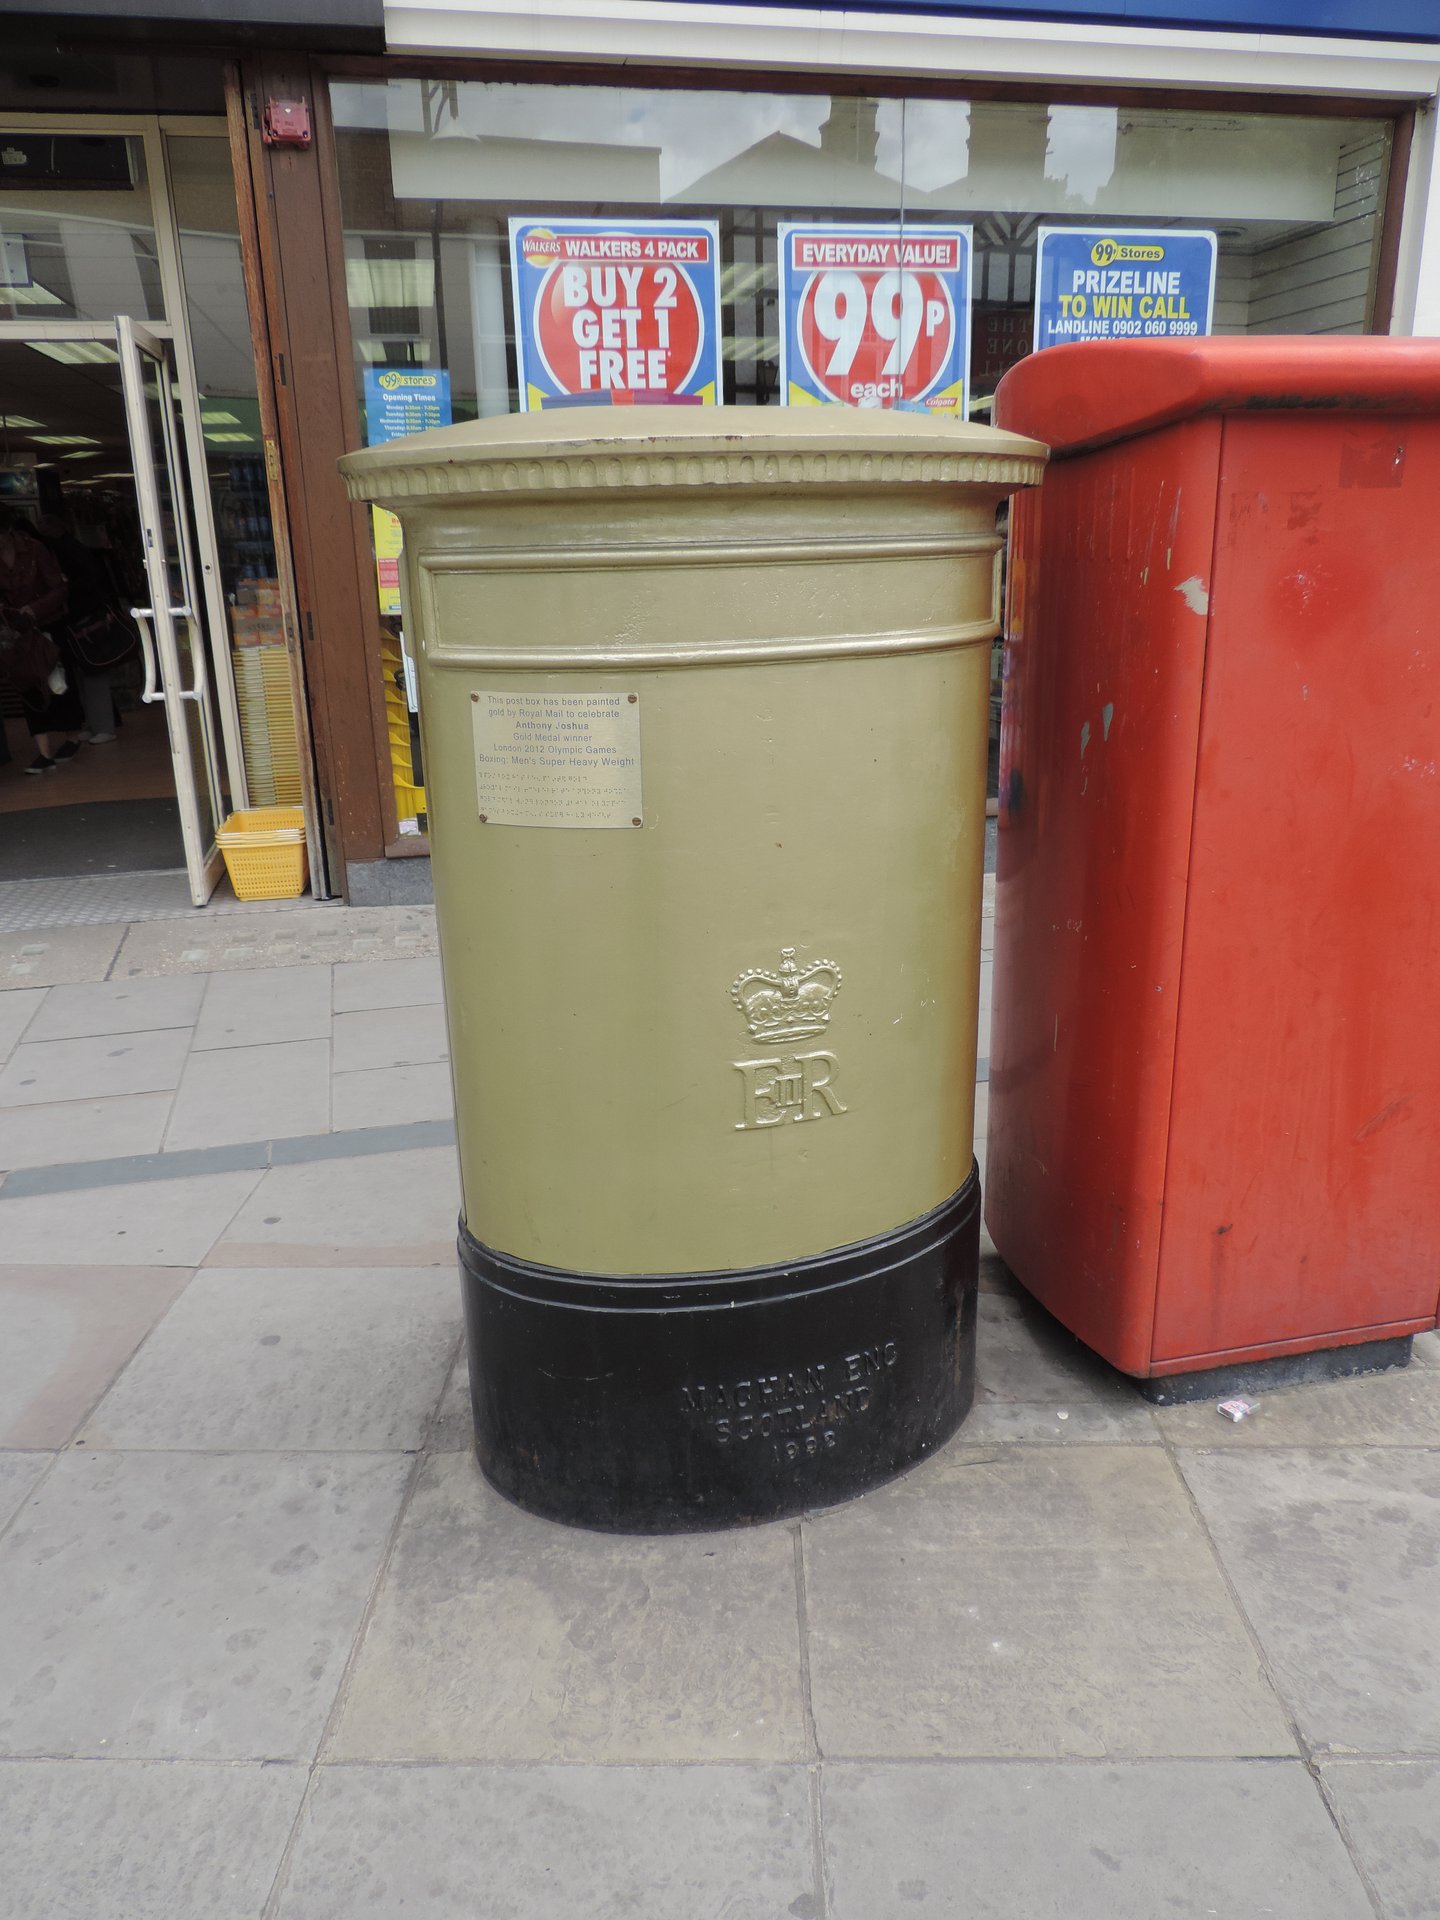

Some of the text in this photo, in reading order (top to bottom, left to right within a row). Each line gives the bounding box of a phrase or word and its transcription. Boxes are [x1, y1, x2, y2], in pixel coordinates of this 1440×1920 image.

[523, 239, 561, 253] WALKERS
[565, 240, 699, 258] WALKERS 4 PACK
[1121, 247, 1160, 259] Stores
[803, 243, 951, 264] EVERYDAY VALUE!
[563, 266, 678, 308] BUY 2
[1072, 270, 1181, 294] PRIZELINE
[1059, 294, 1190, 319] TO WIN CALL
[572, 309, 670, 349] GET 1
[1048, 320, 1198, 335] LANDLINE 0902 060 9999
[404, 376, 433, 385] stores
[850, 379, 903, 398] each
[383, 393, 436, 403] Opening Times
[926, 398, 955, 407] Colgate
[488, 696, 503, 704] This
[506, 697, 523, 706] post
[543, 698, 559, 706] has
[561, 698, 584, 706] been
[586, 698, 620, 707] painted
[488, 708, 620, 719] gold by Royal Mail to celebrate
[515, 721, 589, 731] Anthony Joshua
[513, 733, 532, 741] Gold
[534, 733, 561, 742] Medal
[493, 744, 617, 755] London 2012 Olympic Games
[479, 754, 635, 768] Boxing: Men's Super Heavy Weight
[715, 1385, 871, 1443] SCOTLAND
